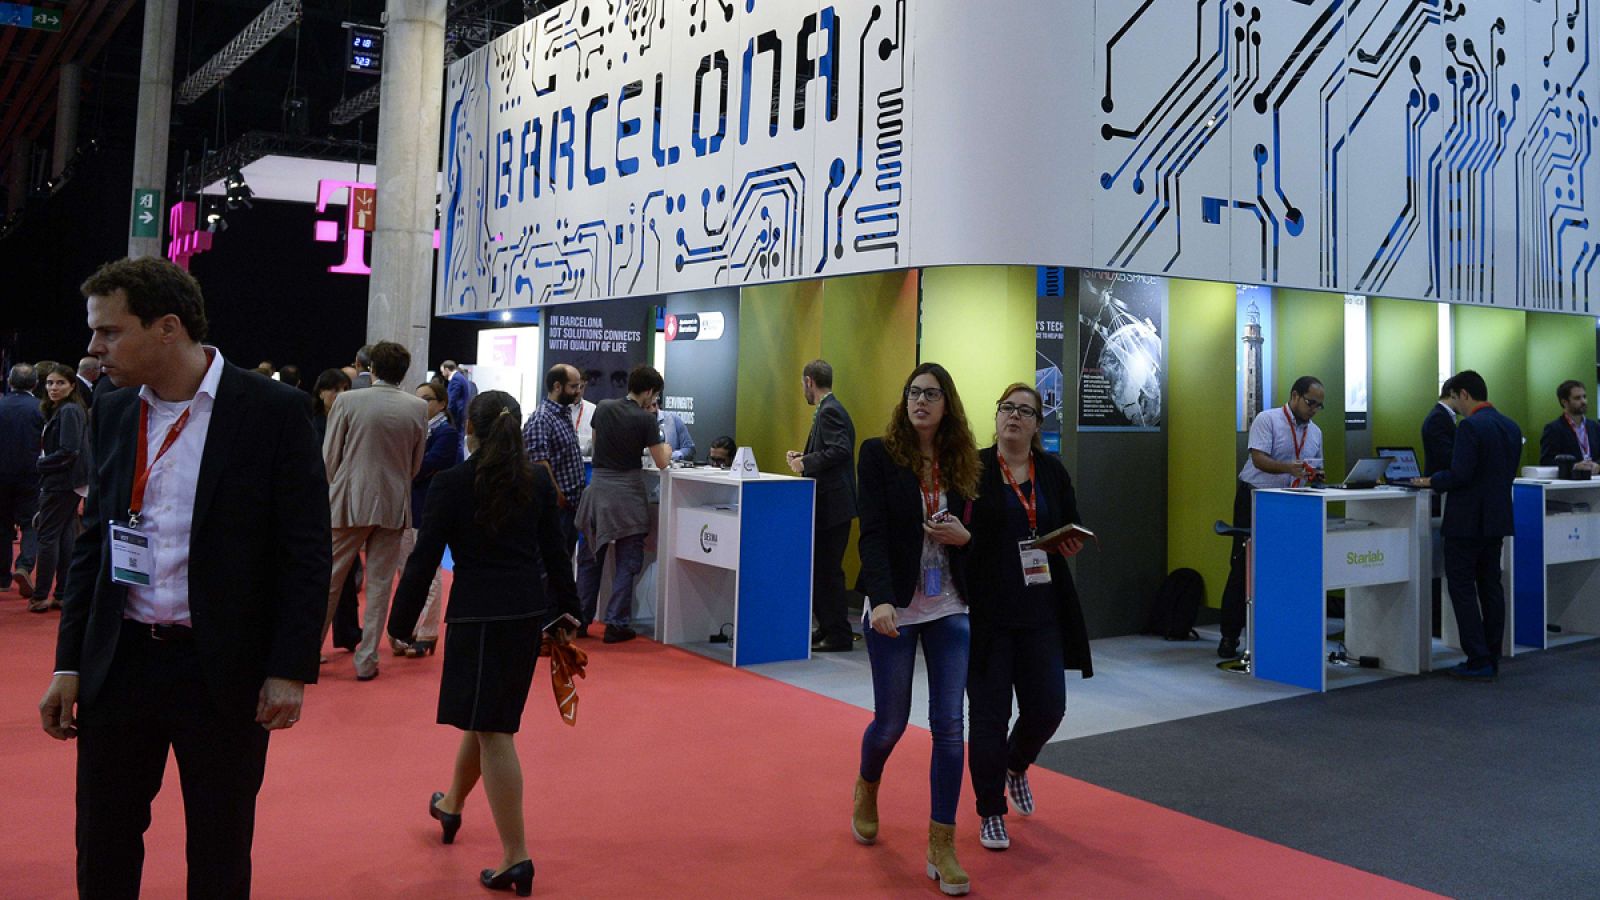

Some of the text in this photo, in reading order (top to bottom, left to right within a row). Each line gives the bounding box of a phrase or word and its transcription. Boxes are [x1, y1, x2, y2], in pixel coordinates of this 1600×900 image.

[493, 6, 842, 210] BARCELONA
[550, 315, 603, 328] IN BARCELONA
[563, 328, 603, 340] SOLUTIONS
[603, 330, 641, 342] CONNECTS
[549, 339, 628, 353] WITH QUALITY OF LIFE
[1346, 549, 1384, 565] Starlab
